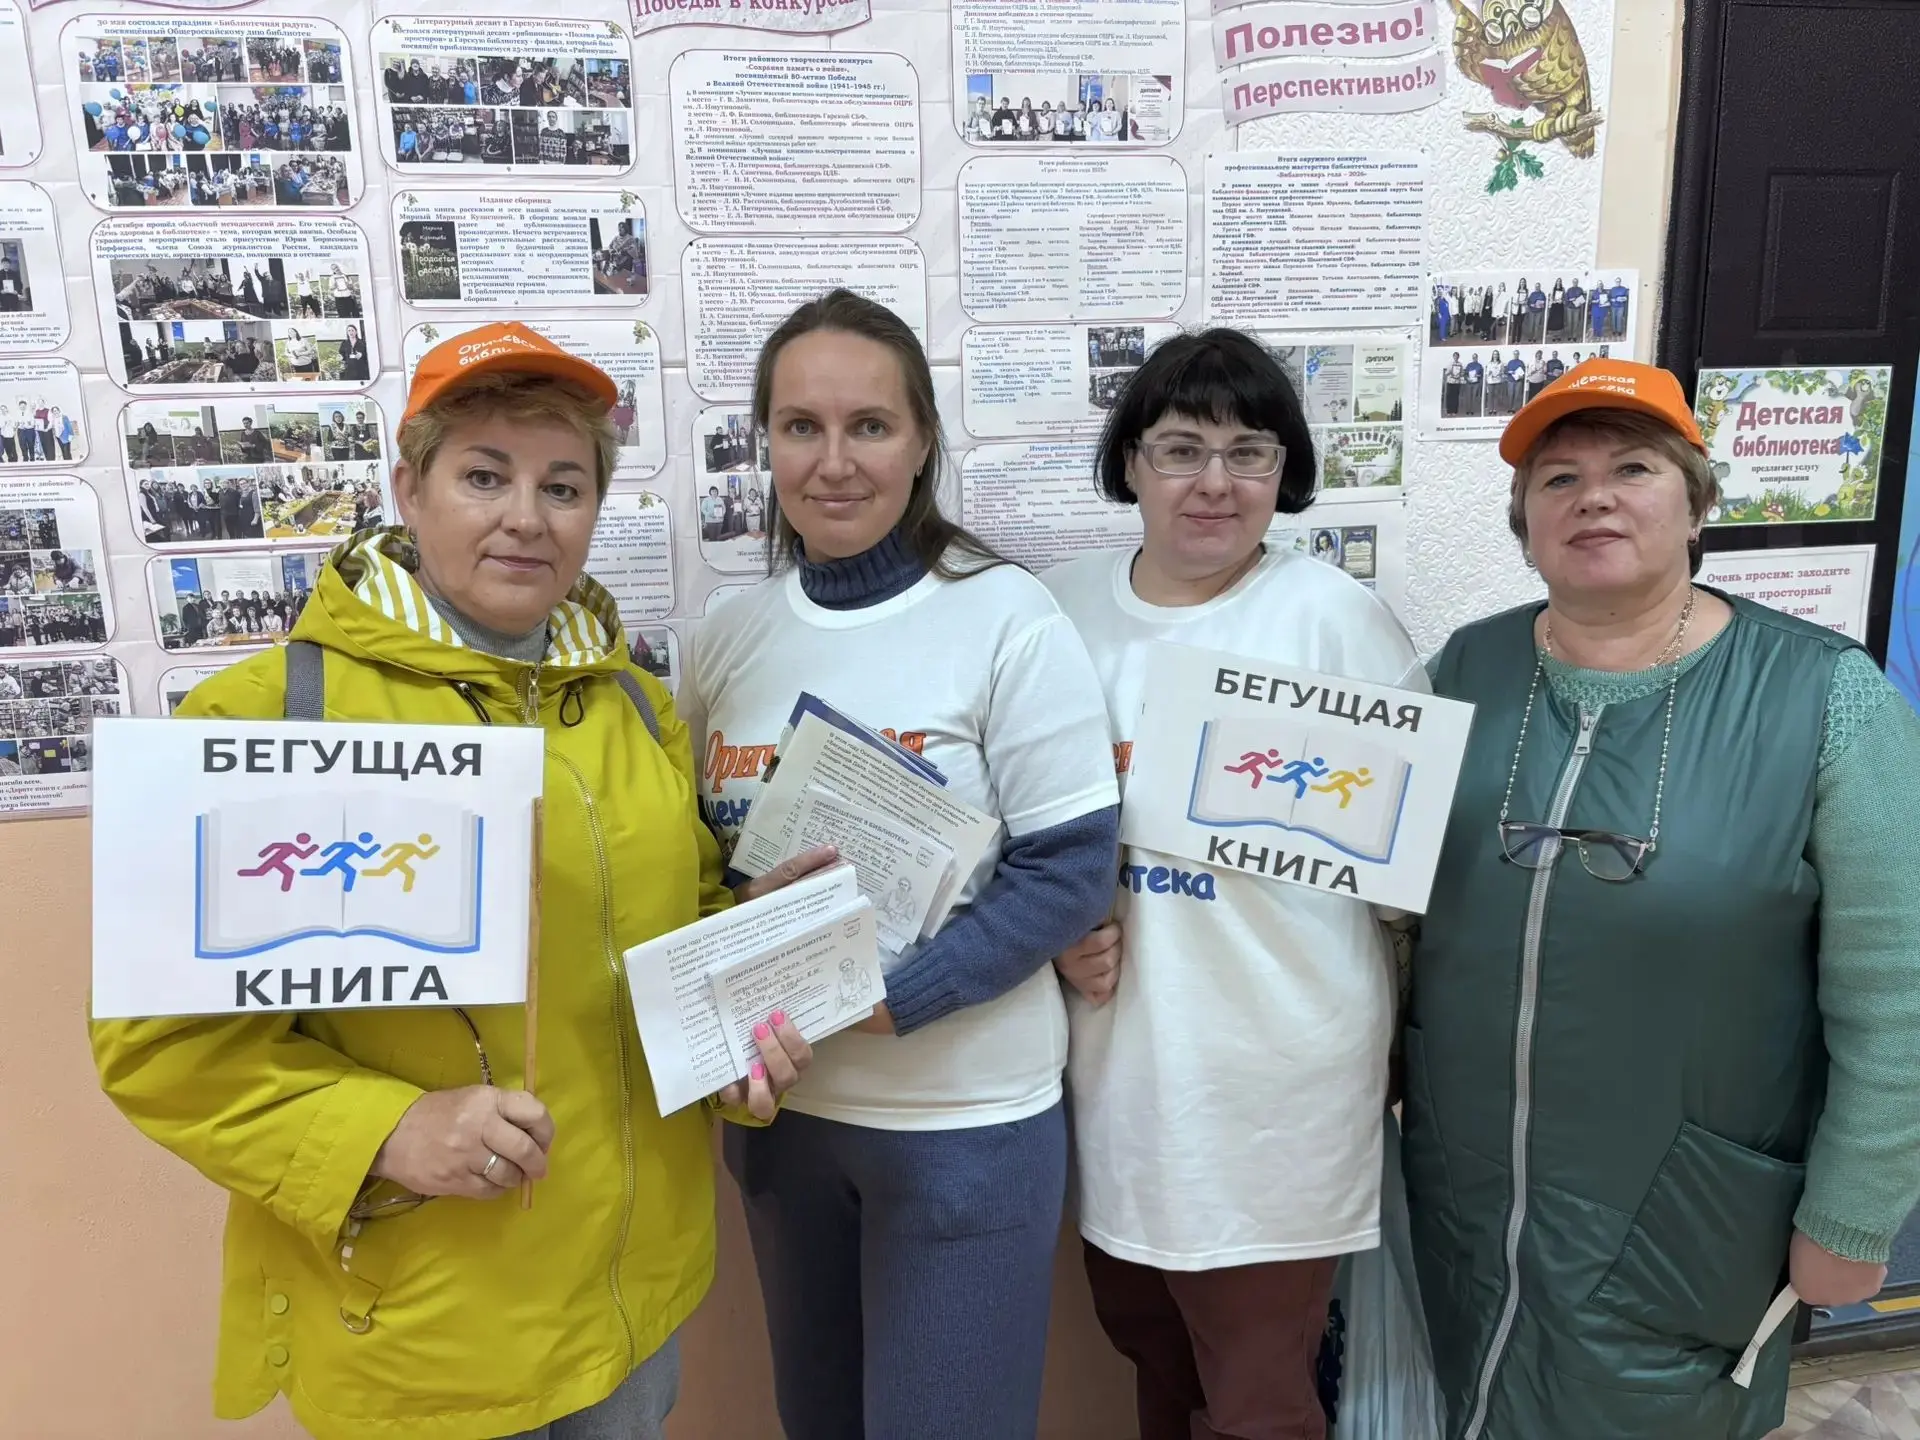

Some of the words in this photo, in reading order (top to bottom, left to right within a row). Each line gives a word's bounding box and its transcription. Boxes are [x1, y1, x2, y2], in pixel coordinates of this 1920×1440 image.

[1225, 7, 1424, 59] Полезно!
[748, 55, 788, 64] районного
[735, 72, 788, 81] посвящённый
[827, 73, 856, 82] Победы
[1233, 65, 1437, 110] Перспективно!»
[479, 196, 513, 205] Издание
[514, 196, 551, 205] сборника
[1736, 401, 1844, 431] Детская
[1733, 434, 1840, 457] библиотека
[1752, 464, 1793, 473] предлагает
[1795, 464, 1819, 473] услугу
[1760, 474, 1809, 484] копирования
[1707, 573, 1741, 583] Очень
[1745, 571, 1794, 582] просим:
[1797, 567, 1850, 577] заходите
[1759, 585, 1832, 600] просторный
[1792, 605, 1818, 616] дом!
[1214, 667, 1422, 733] БЕГУЩАЯ
[203, 738, 482, 781] БЕГУЩАЯ
[813, 797, 863, 824] ПРИГЛАШЕНИЕ
[867, 821, 910, 845] БИБЛИОТЕКУ
[1206, 835, 1359, 894] КНИГА
[723, 953, 780, 983] ПРИГЛАШЕНИЕ
[784, 930, 833, 956] БИБЛИОТЕКУ
[236, 965, 448, 1007] КНИГА
